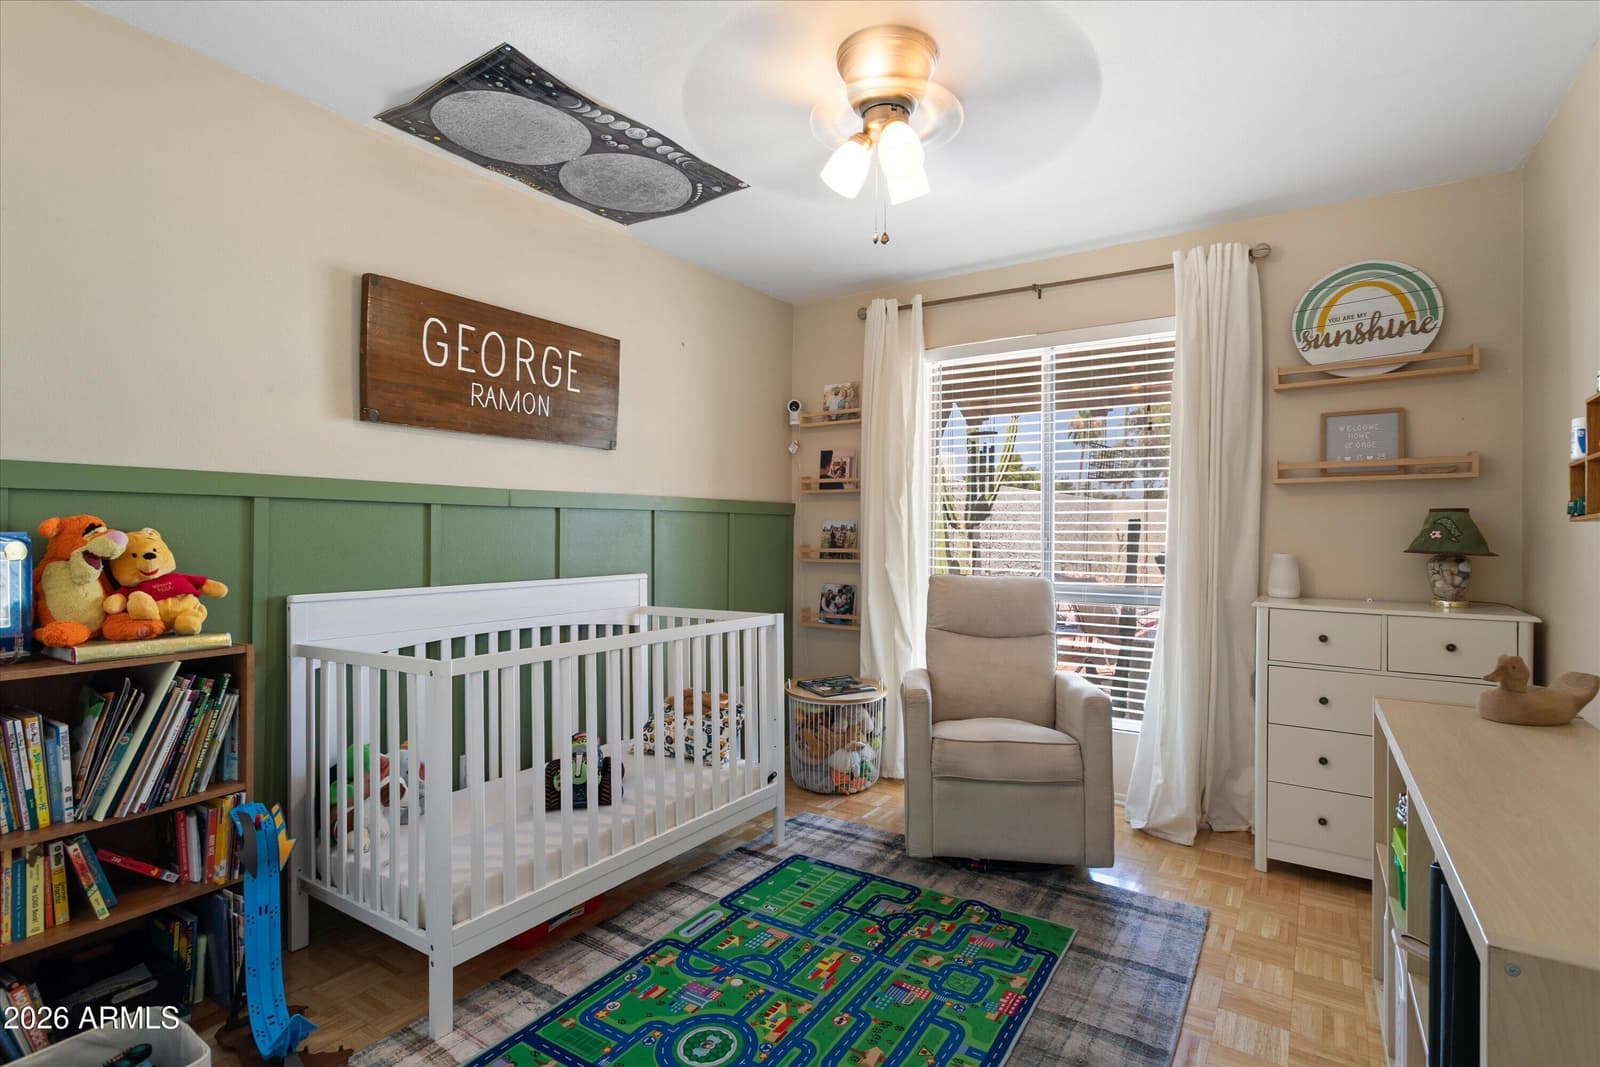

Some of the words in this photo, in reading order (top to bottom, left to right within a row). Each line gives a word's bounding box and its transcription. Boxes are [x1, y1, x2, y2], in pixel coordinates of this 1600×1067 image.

[1301, 311, 1439, 352] sunshine
[422, 317, 583, 393] GEORGE
[471, 382, 550, 417] RAMON
